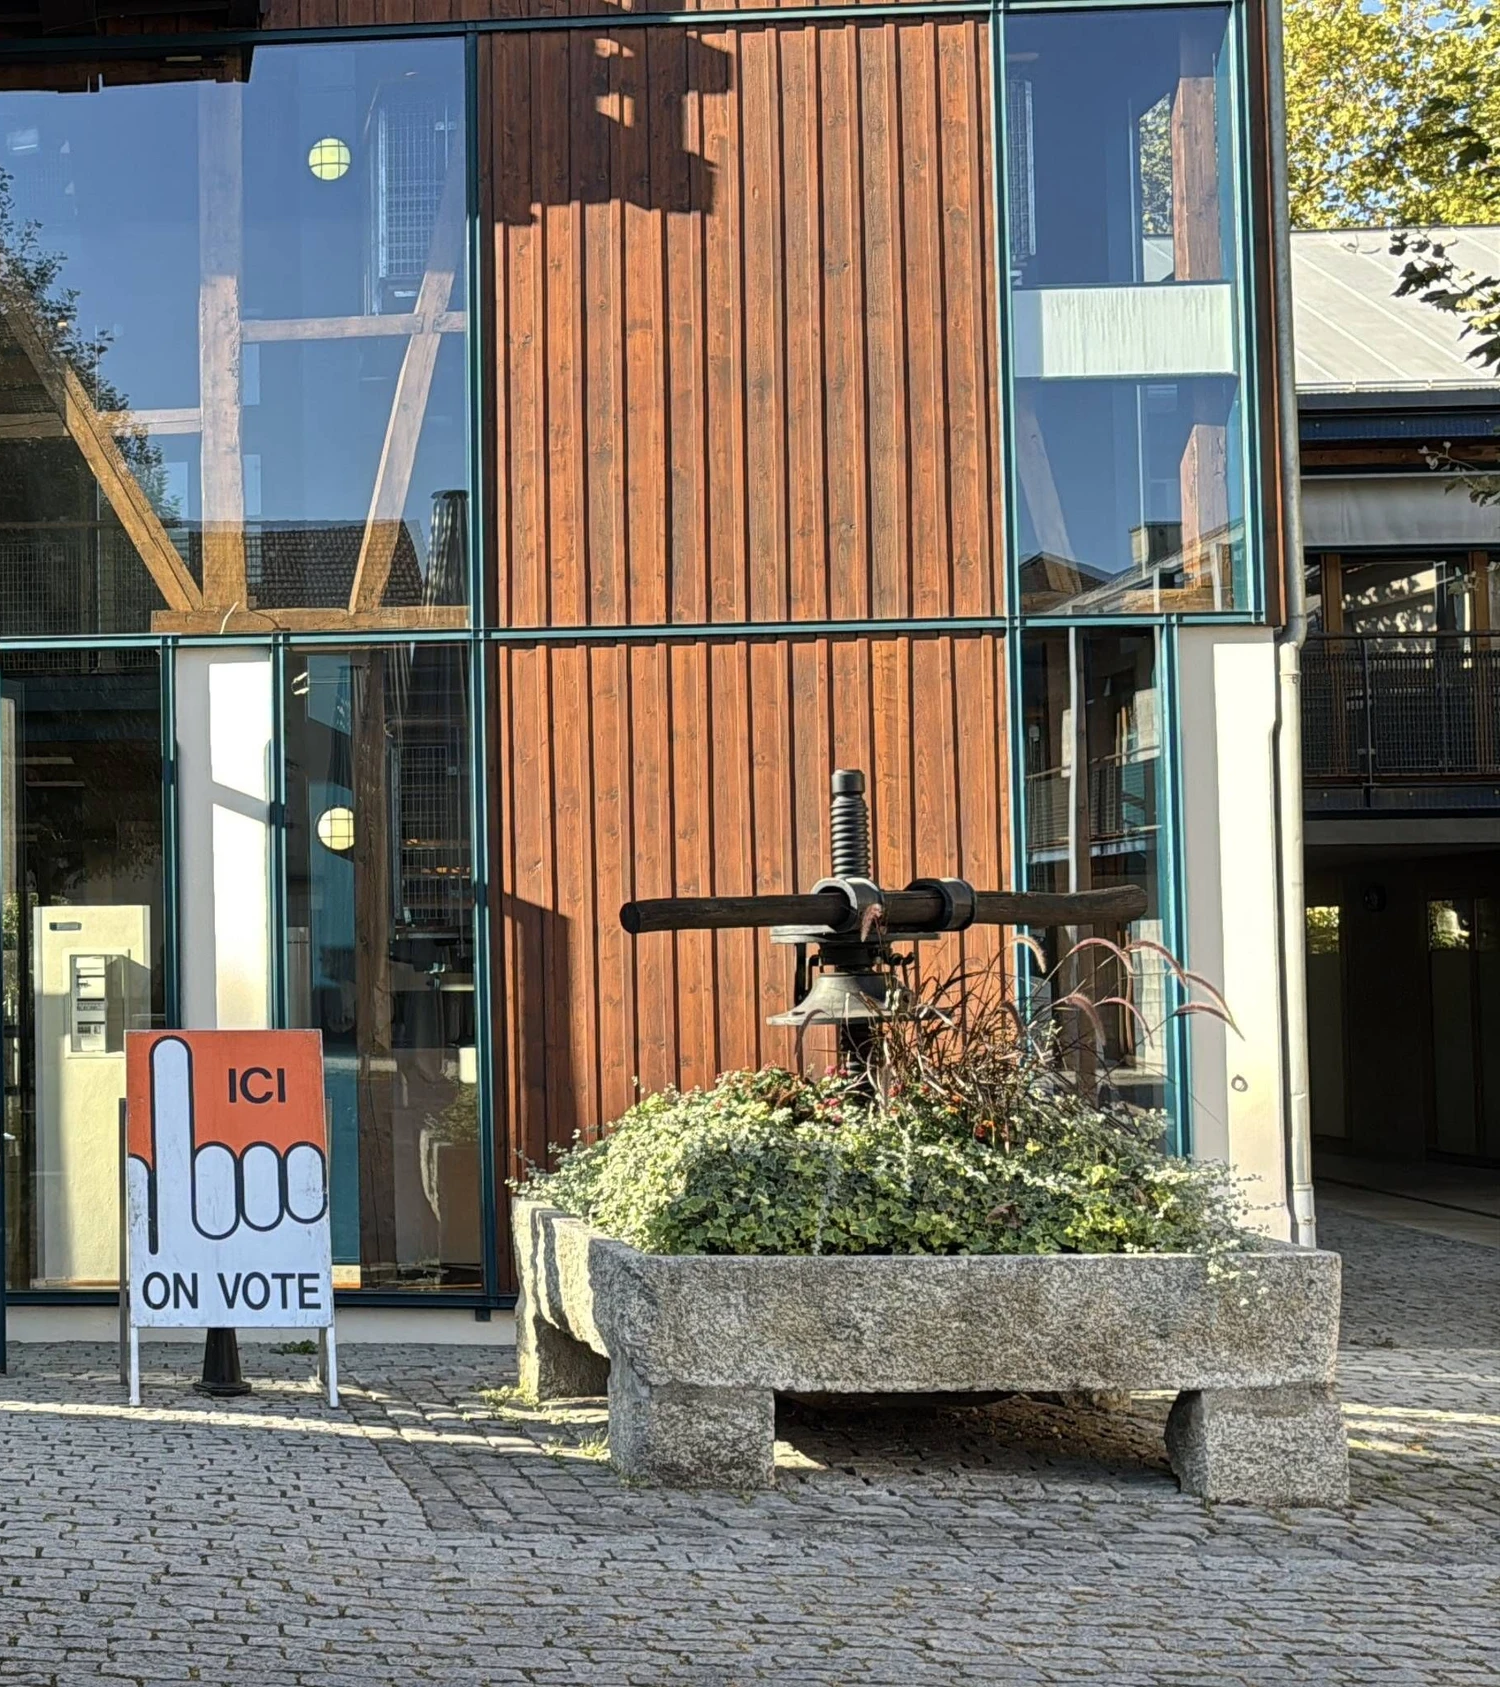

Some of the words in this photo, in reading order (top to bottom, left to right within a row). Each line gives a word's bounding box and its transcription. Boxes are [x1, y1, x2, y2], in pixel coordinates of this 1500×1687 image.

[228, 1067, 286, 1104] ICI
[142, 1271, 198, 1310] ON
[217, 1271, 322, 1310] VOTE
